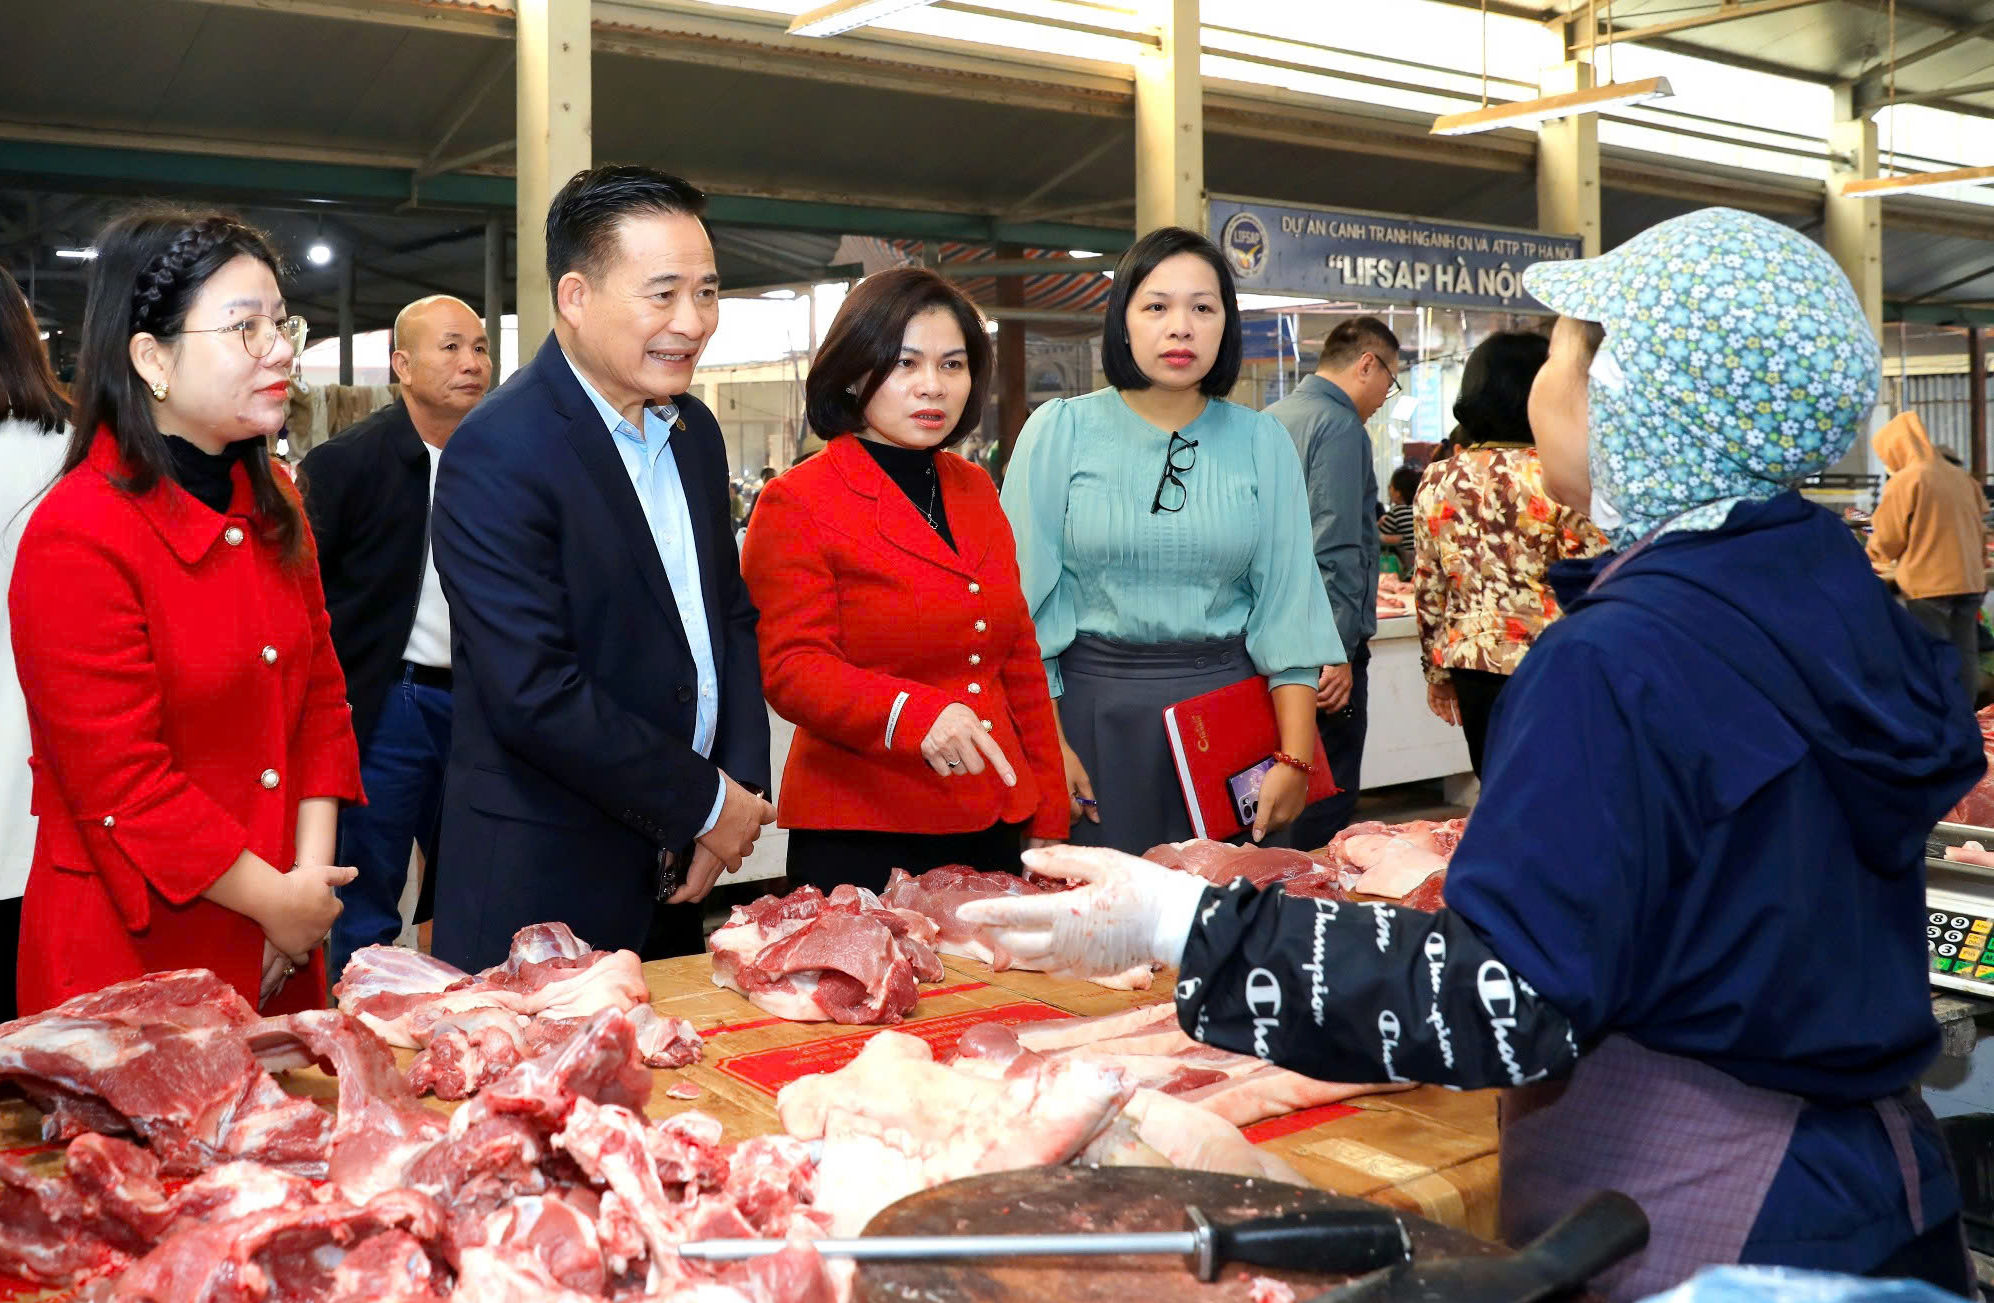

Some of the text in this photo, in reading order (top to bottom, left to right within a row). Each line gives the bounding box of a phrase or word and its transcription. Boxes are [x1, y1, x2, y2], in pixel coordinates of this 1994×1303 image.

[1282, 215, 1304, 238] DỰ
[1368, 225, 1411, 245] TRANH
[1456, 234, 1473, 250] CN
[1492, 239, 1520, 256] ATTP
[1522, 242, 1536, 258] TP
[1435, 256, 1474, 295] HÀ
[1478, 261, 1523, 305] NỘI
